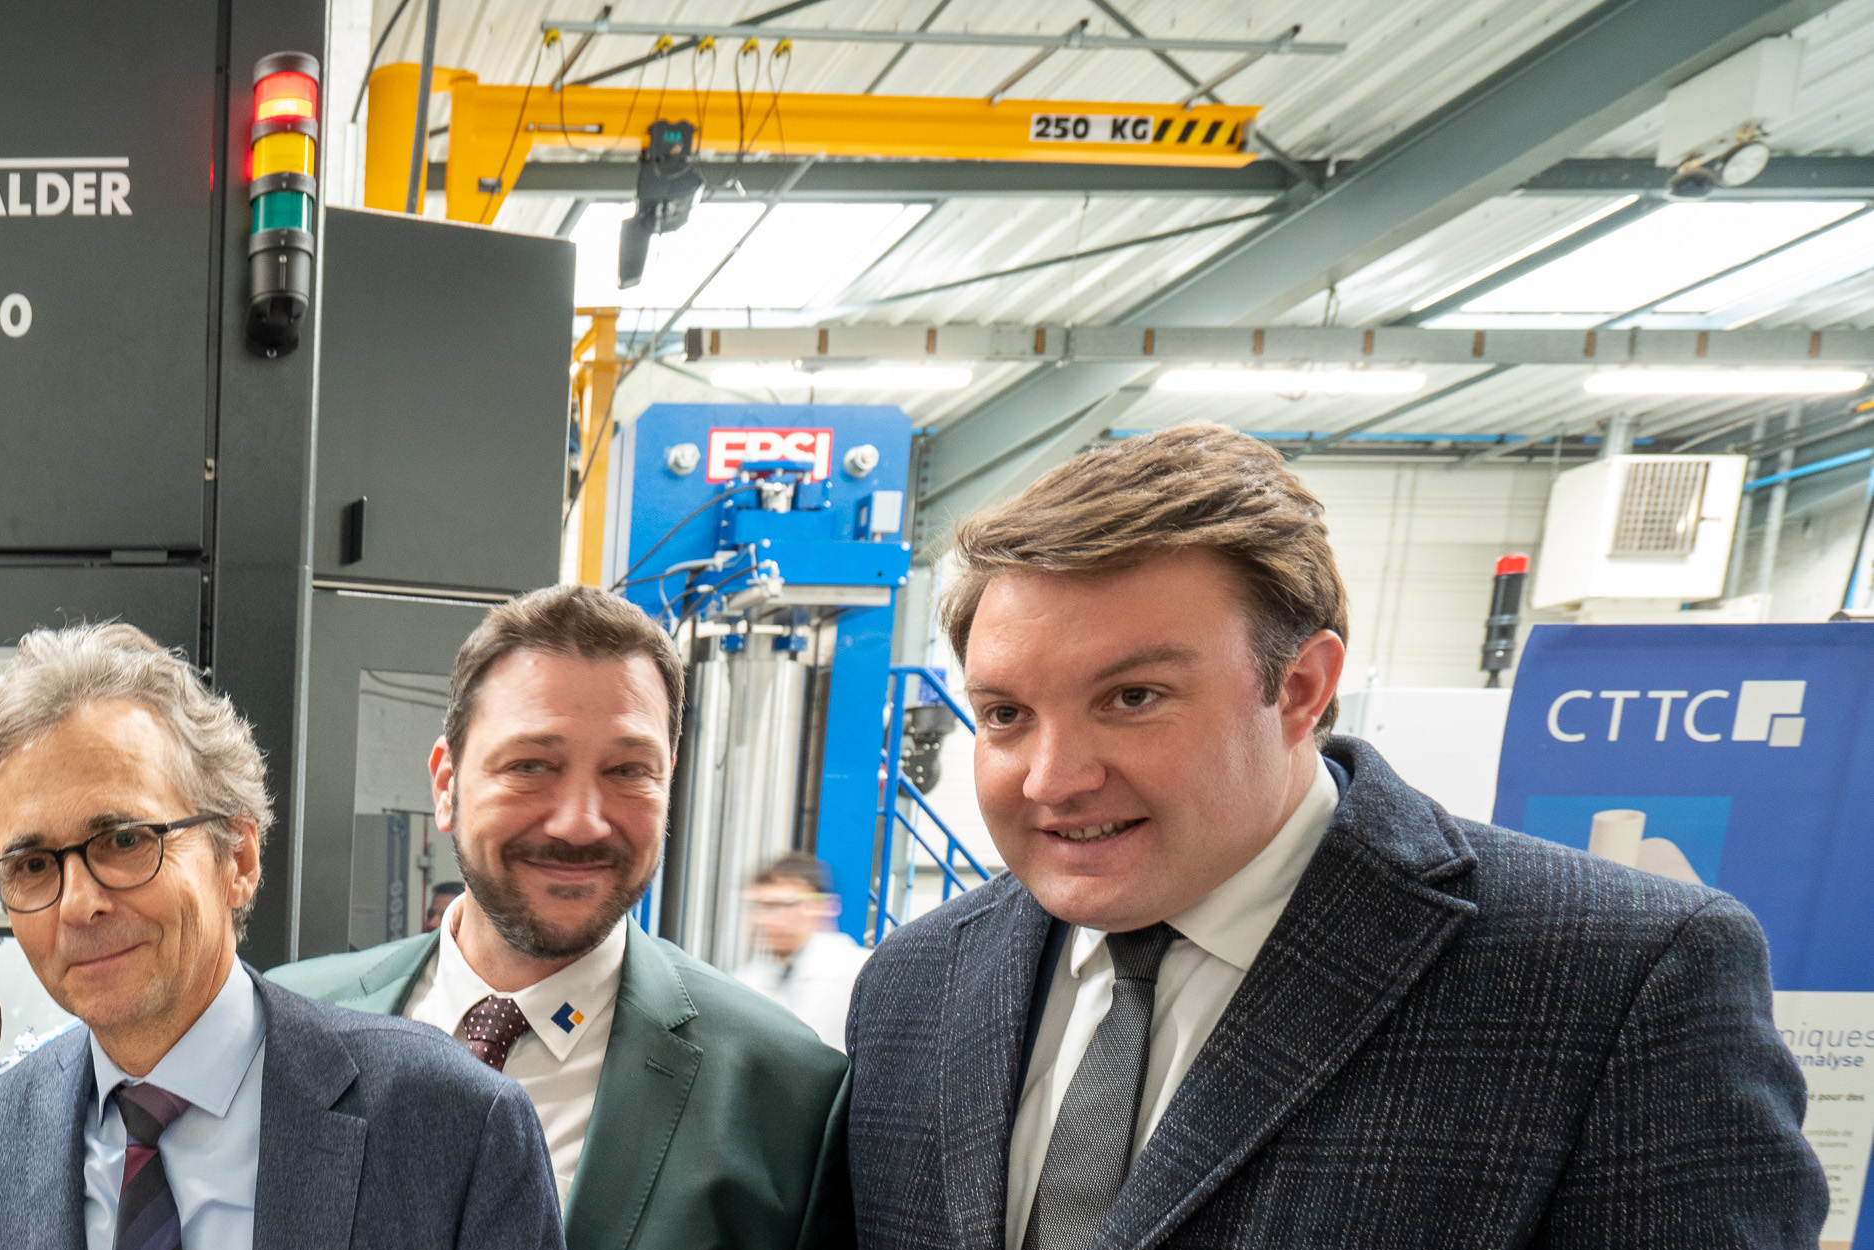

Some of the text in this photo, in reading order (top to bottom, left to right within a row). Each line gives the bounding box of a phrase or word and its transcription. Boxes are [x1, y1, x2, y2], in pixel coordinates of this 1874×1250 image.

[1034, 116, 1149, 141] 250 KG
[1546, 688, 1730, 743] CTTC
